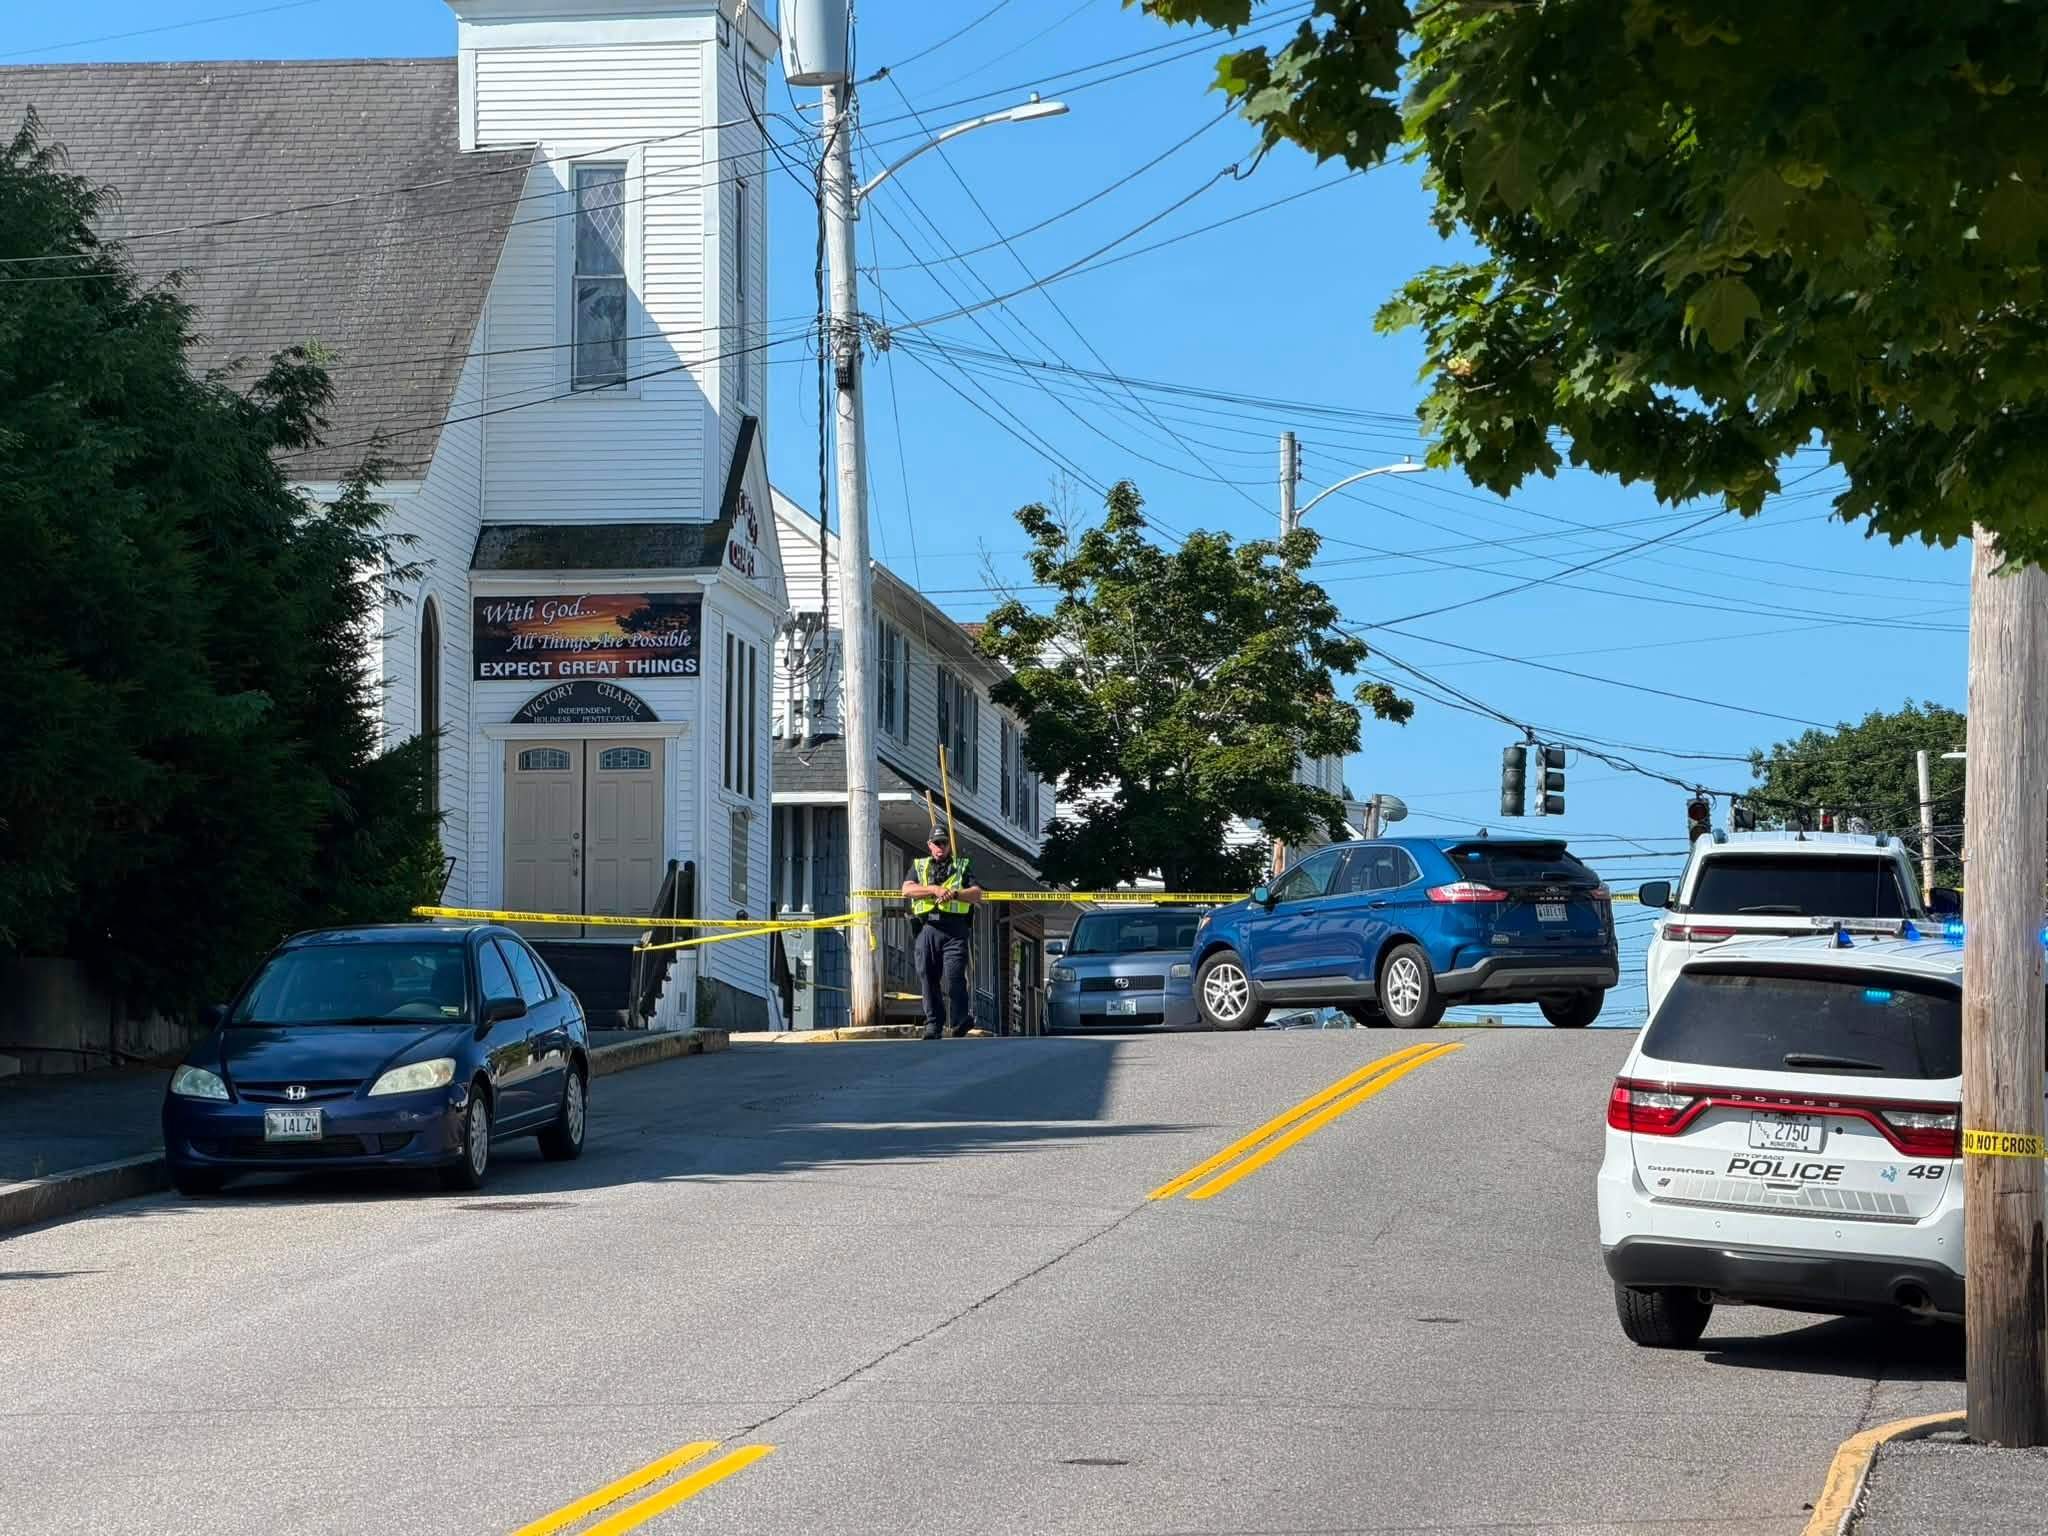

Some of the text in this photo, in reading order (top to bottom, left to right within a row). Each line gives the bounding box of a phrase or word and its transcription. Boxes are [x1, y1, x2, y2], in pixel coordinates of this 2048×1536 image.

[483, 596, 597, 625] With God...
[506, 629, 692, 653] All Things Are Possible
[480, 658, 697, 677] EXPECT GREAT THINGS
[523, 683, 641, 719] VICTORY CHAPEL
[558, 706, 612, 714] INDEPENDENT
[582, 715, 635, 723] PENTECOSTAL
[1731, 1094, 1840, 1108] DODGE
[1775, 1121, 1810, 1142] 2750
[1976, 1135, 1999, 1151] NOT
[2001, 1136, 2037, 1154] CROSS
[1648, 1164, 1715, 1176] DURANGO
[1727, 1158, 1845, 1181] POLICE
[1908, 1164, 1945, 1180] 49
